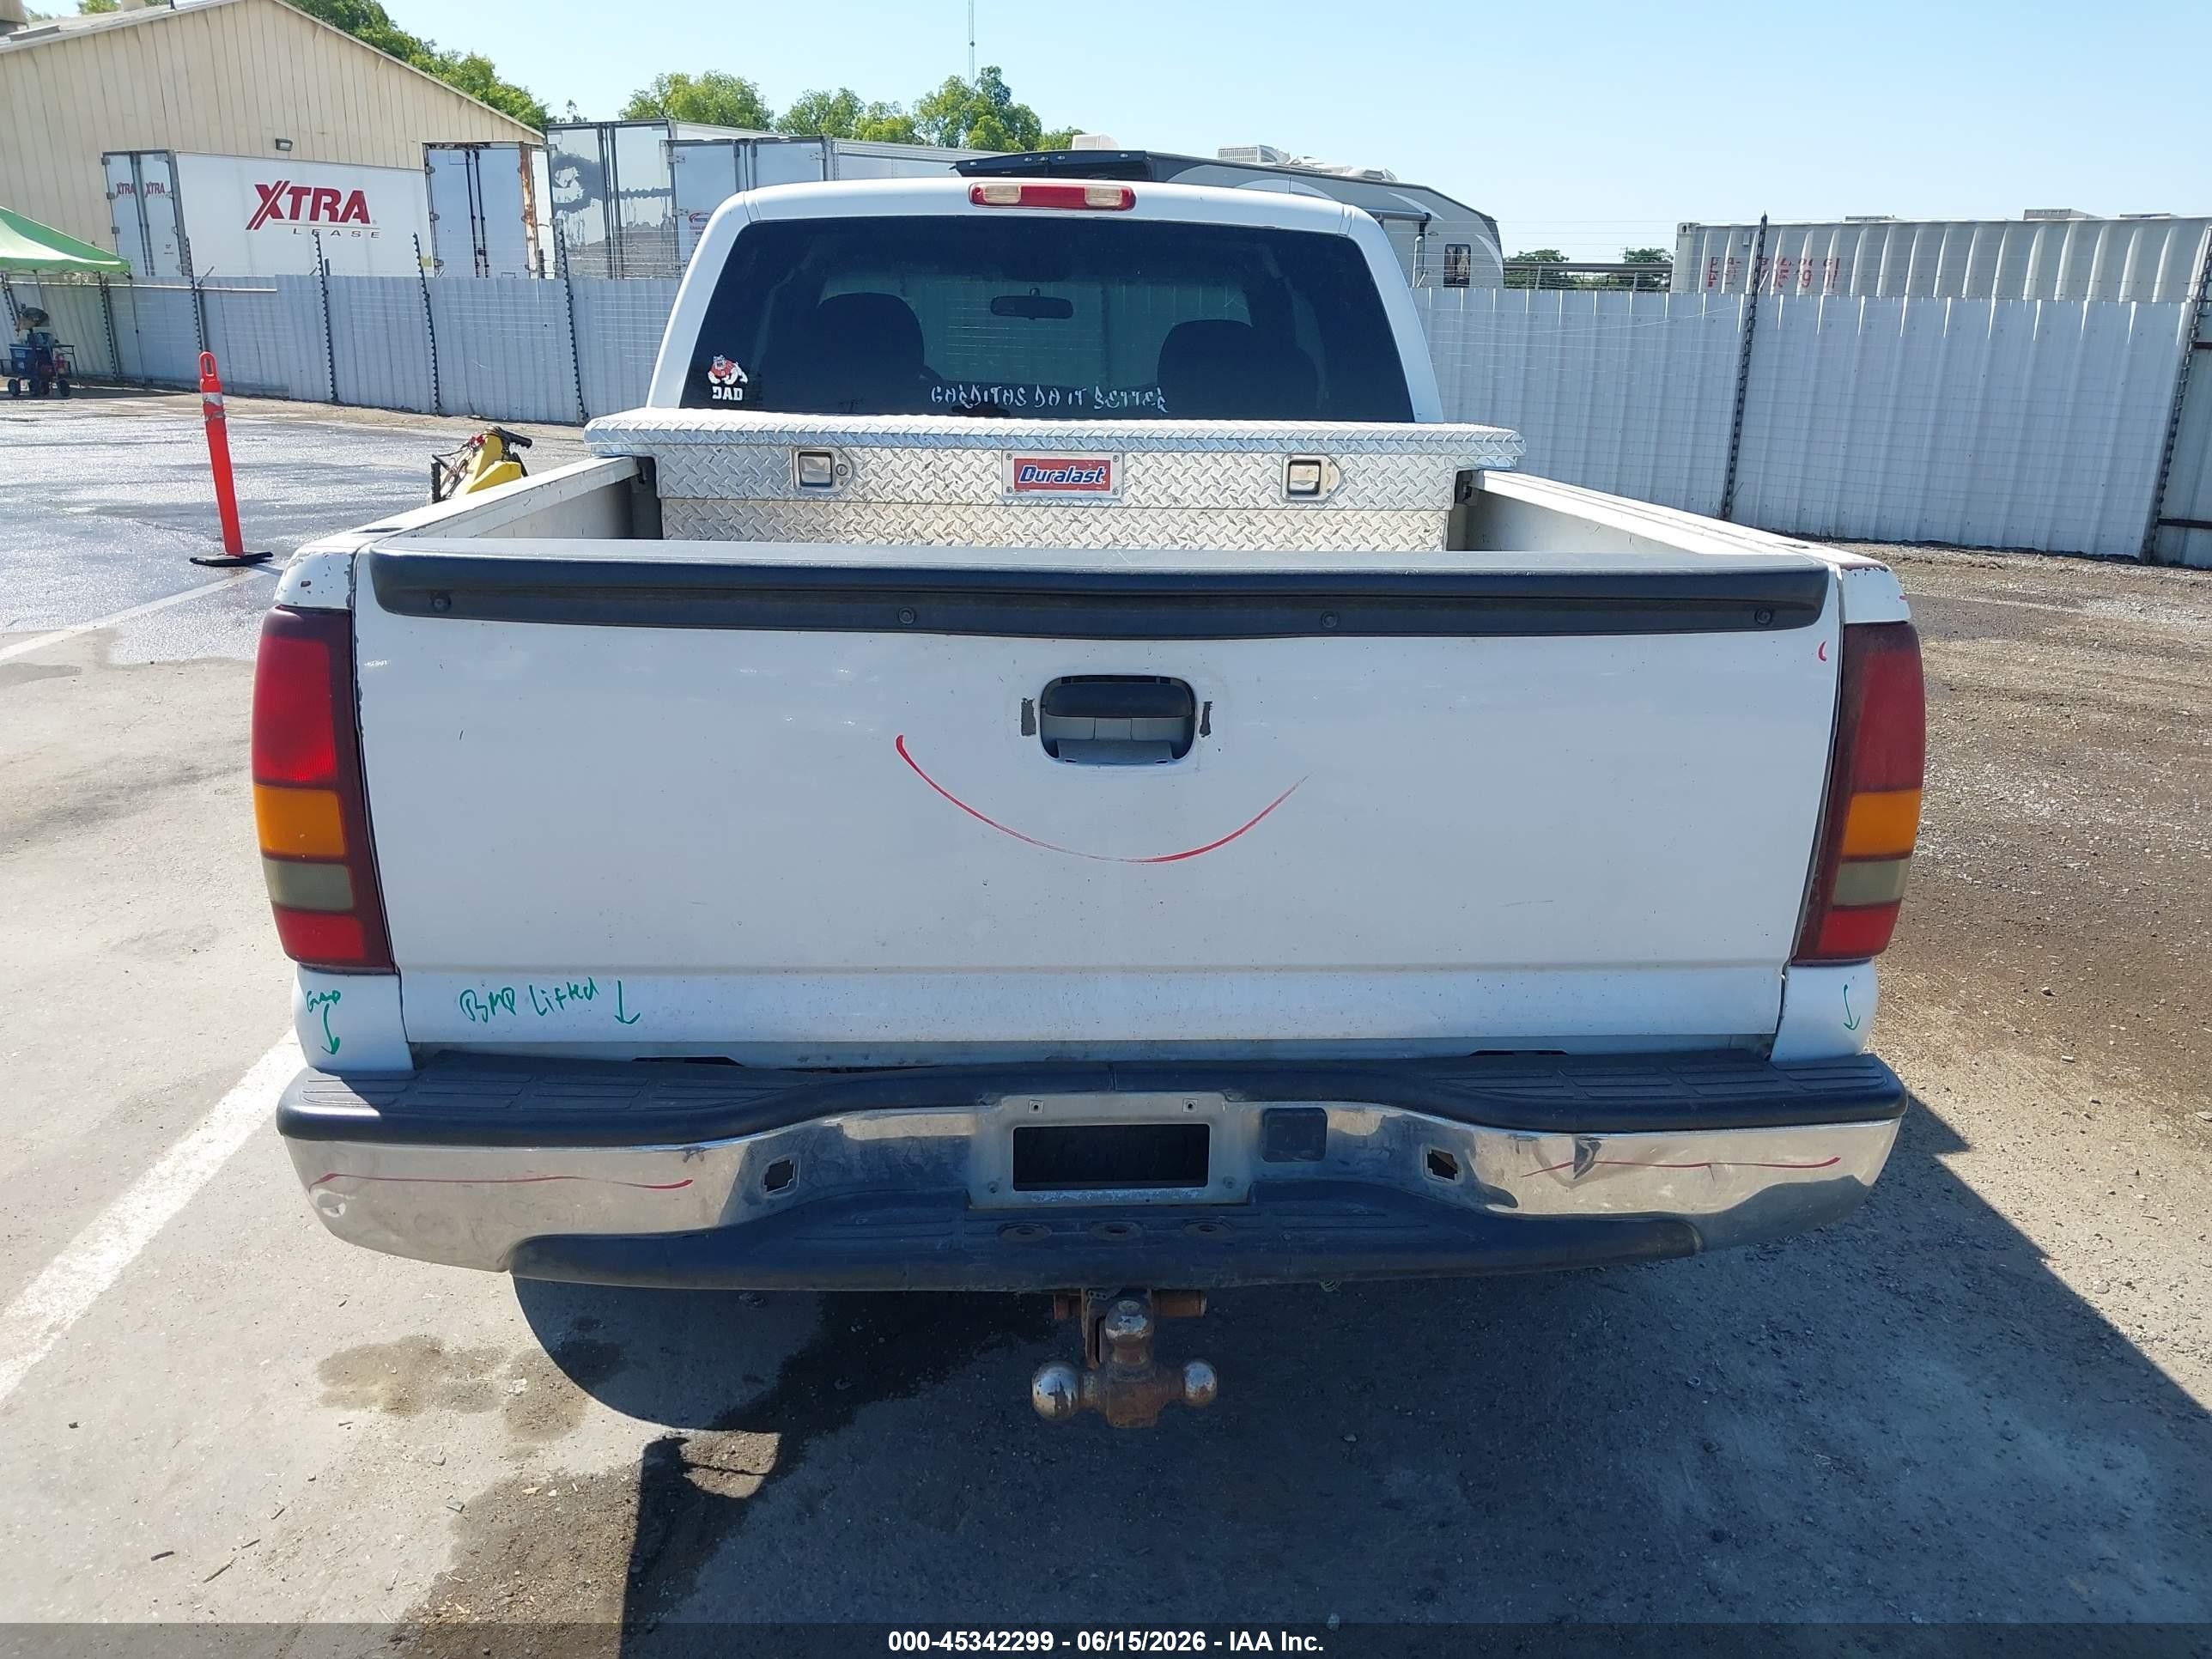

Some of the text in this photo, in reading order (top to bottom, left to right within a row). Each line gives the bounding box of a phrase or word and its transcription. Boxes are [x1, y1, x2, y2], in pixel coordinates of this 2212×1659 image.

[145, 181, 165, 198] XTRA
[246, 180, 370, 230] XTRA
[293, 228, 380, 239] LEASE
[712, 386, 743, 401] DAD
[1018, 465, 1106, 484] Duralast
